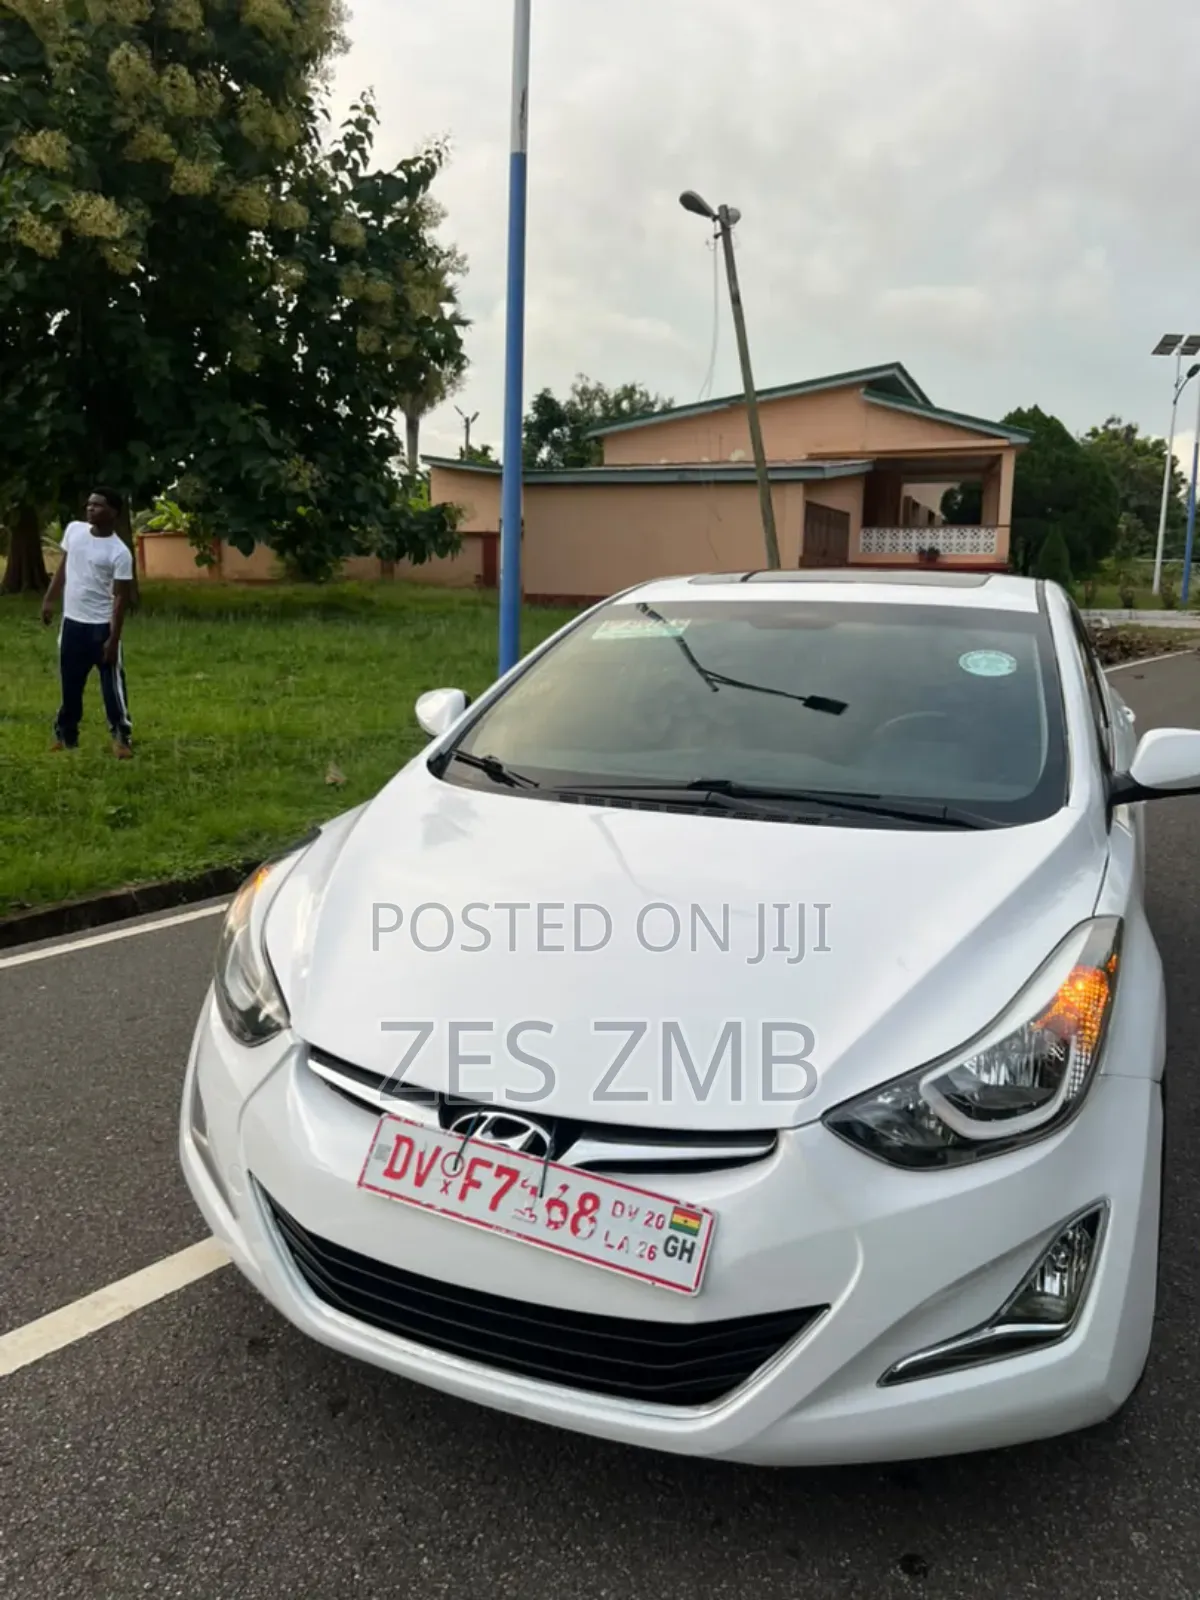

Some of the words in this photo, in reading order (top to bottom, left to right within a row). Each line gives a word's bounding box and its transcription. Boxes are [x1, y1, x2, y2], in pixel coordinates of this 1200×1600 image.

[383, 1134, 441, 1188] DV
[644, 1210, 666, 1230] 20
[664, 1235, 696, 1264] GH
